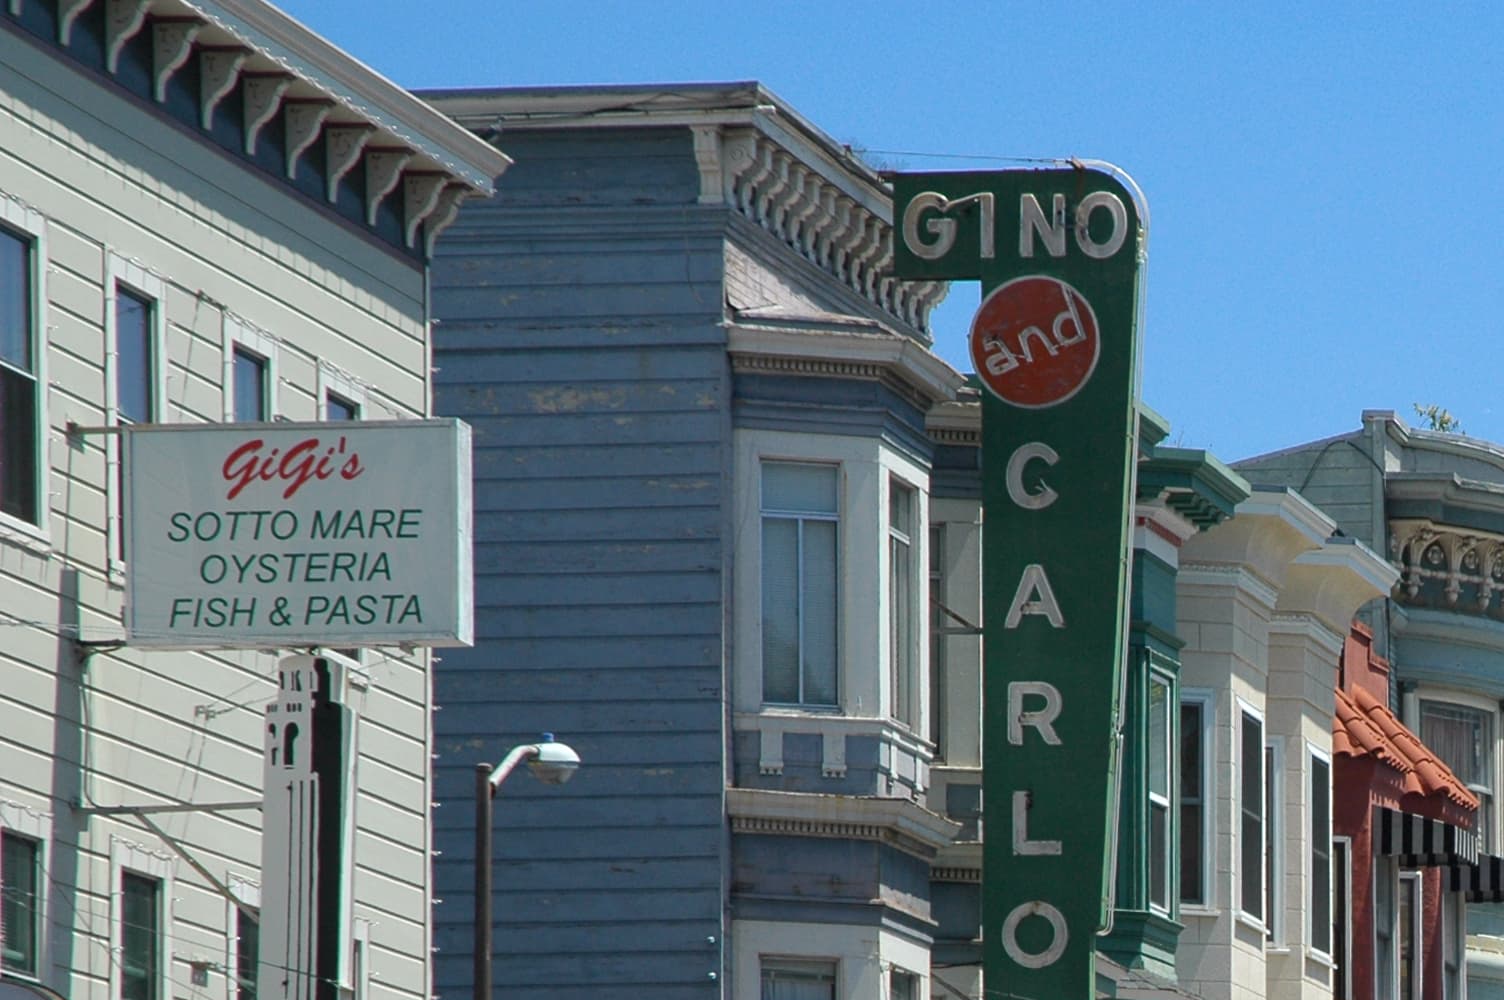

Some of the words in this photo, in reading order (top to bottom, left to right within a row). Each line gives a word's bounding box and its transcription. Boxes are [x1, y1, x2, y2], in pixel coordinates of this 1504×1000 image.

[902, 190, 1128, 259] GINO
[983, 282, 1087, 377] and
[222, 436, 365, 500] GiGi's
[167, 510, 298, 542] SOTTO
[310, 509, 423, 539] MARE
[200, 552, 392, 584] OYSTERIA
[169, 597, 257, 628] FISH
[269, 597, 291, 626] &
[304, 595, 423, 625] PASTA
[1001, 441, 1069, 969] CARLO
